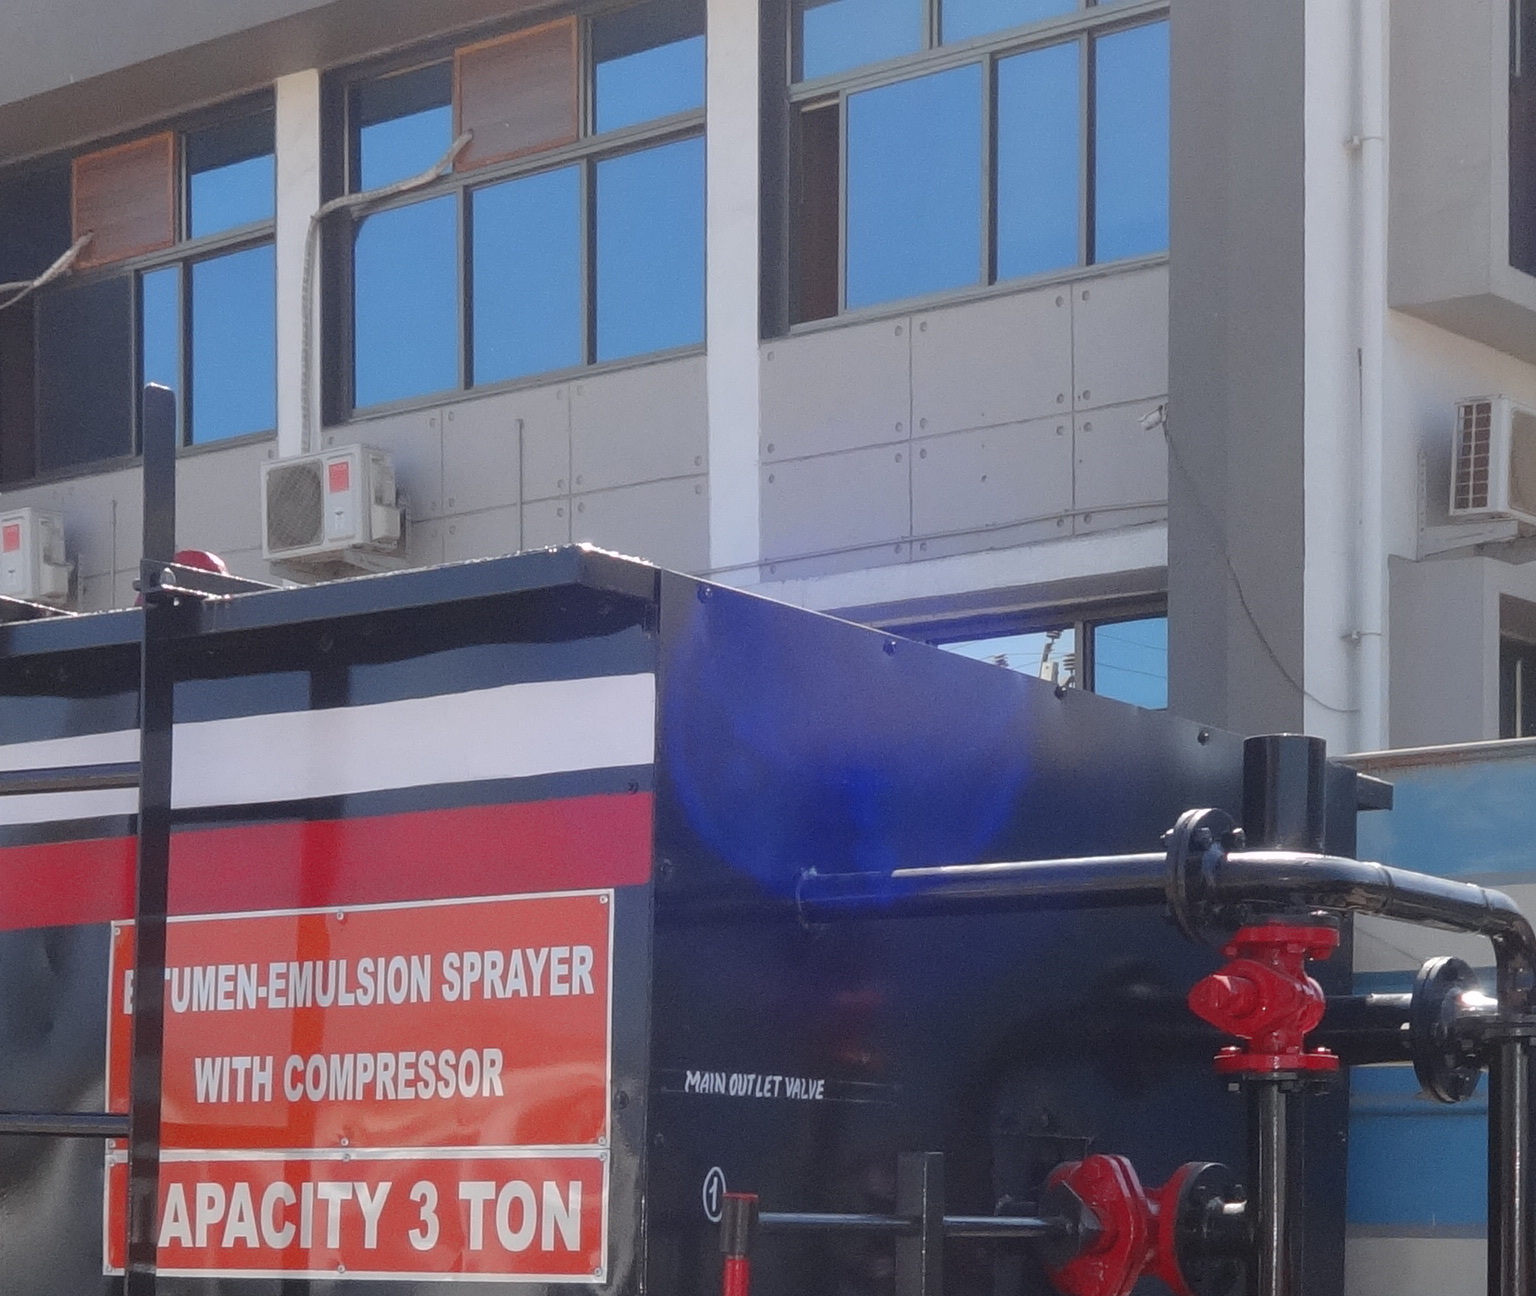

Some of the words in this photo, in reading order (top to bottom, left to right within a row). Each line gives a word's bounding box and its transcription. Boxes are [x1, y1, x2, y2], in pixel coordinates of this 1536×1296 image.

[124, 954, 431, 1014] UMEN-EMULSION
[442, 945, 594, 1001] SPRAYER
[195, 1056, 273, 1103] WITH
[284, 1048, 504, 1101] COMPRESSOR
[685, 1070, 725, 1094] MAIN
[785, 1077, 825, 1100] VALVE
[157, 1181, 392, 1249] APACITY
[408, 1181, 440, 1251] 3
[458, 1180, 583, 1252] TON
